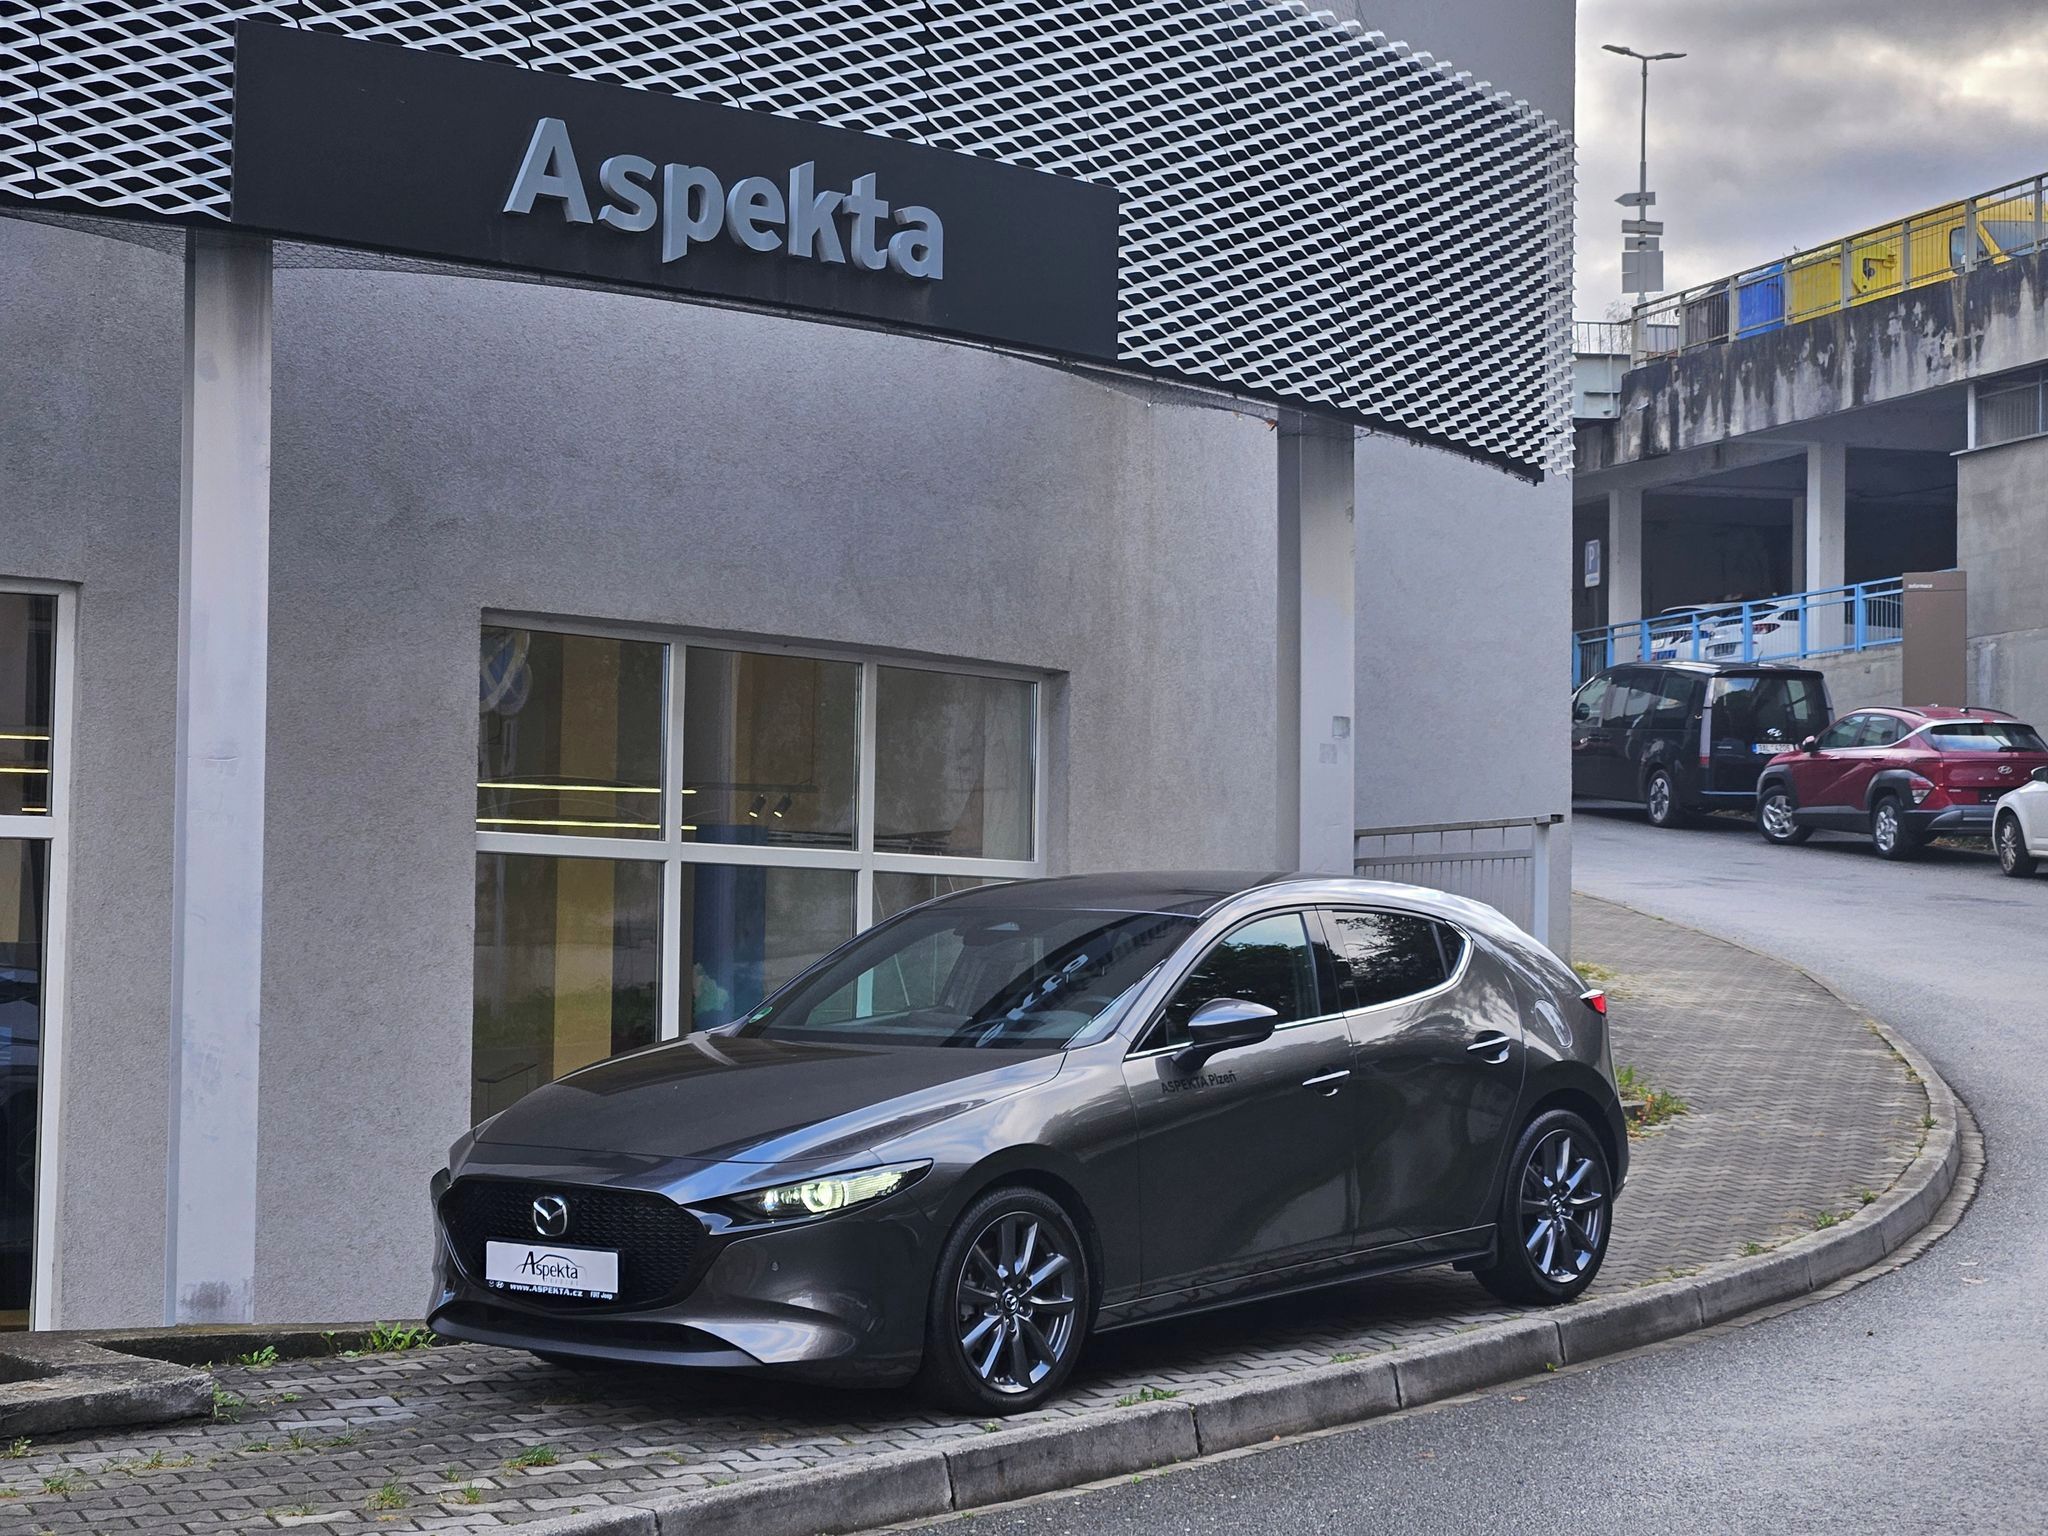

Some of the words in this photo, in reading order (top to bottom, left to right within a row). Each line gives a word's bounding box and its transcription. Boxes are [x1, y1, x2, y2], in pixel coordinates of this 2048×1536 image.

[502, 117, 944, 281] Aspekta
[1588, 545, 1596, 570] P
[1161, 1076, 1209, 1094] ASPEKTA
[1208, 1070, 1238, 1086] Plzeň
[521, 1251, 579, 1281] Aspekta
[509, 1283, 584, 1298] www.ASPEKTA.cz
